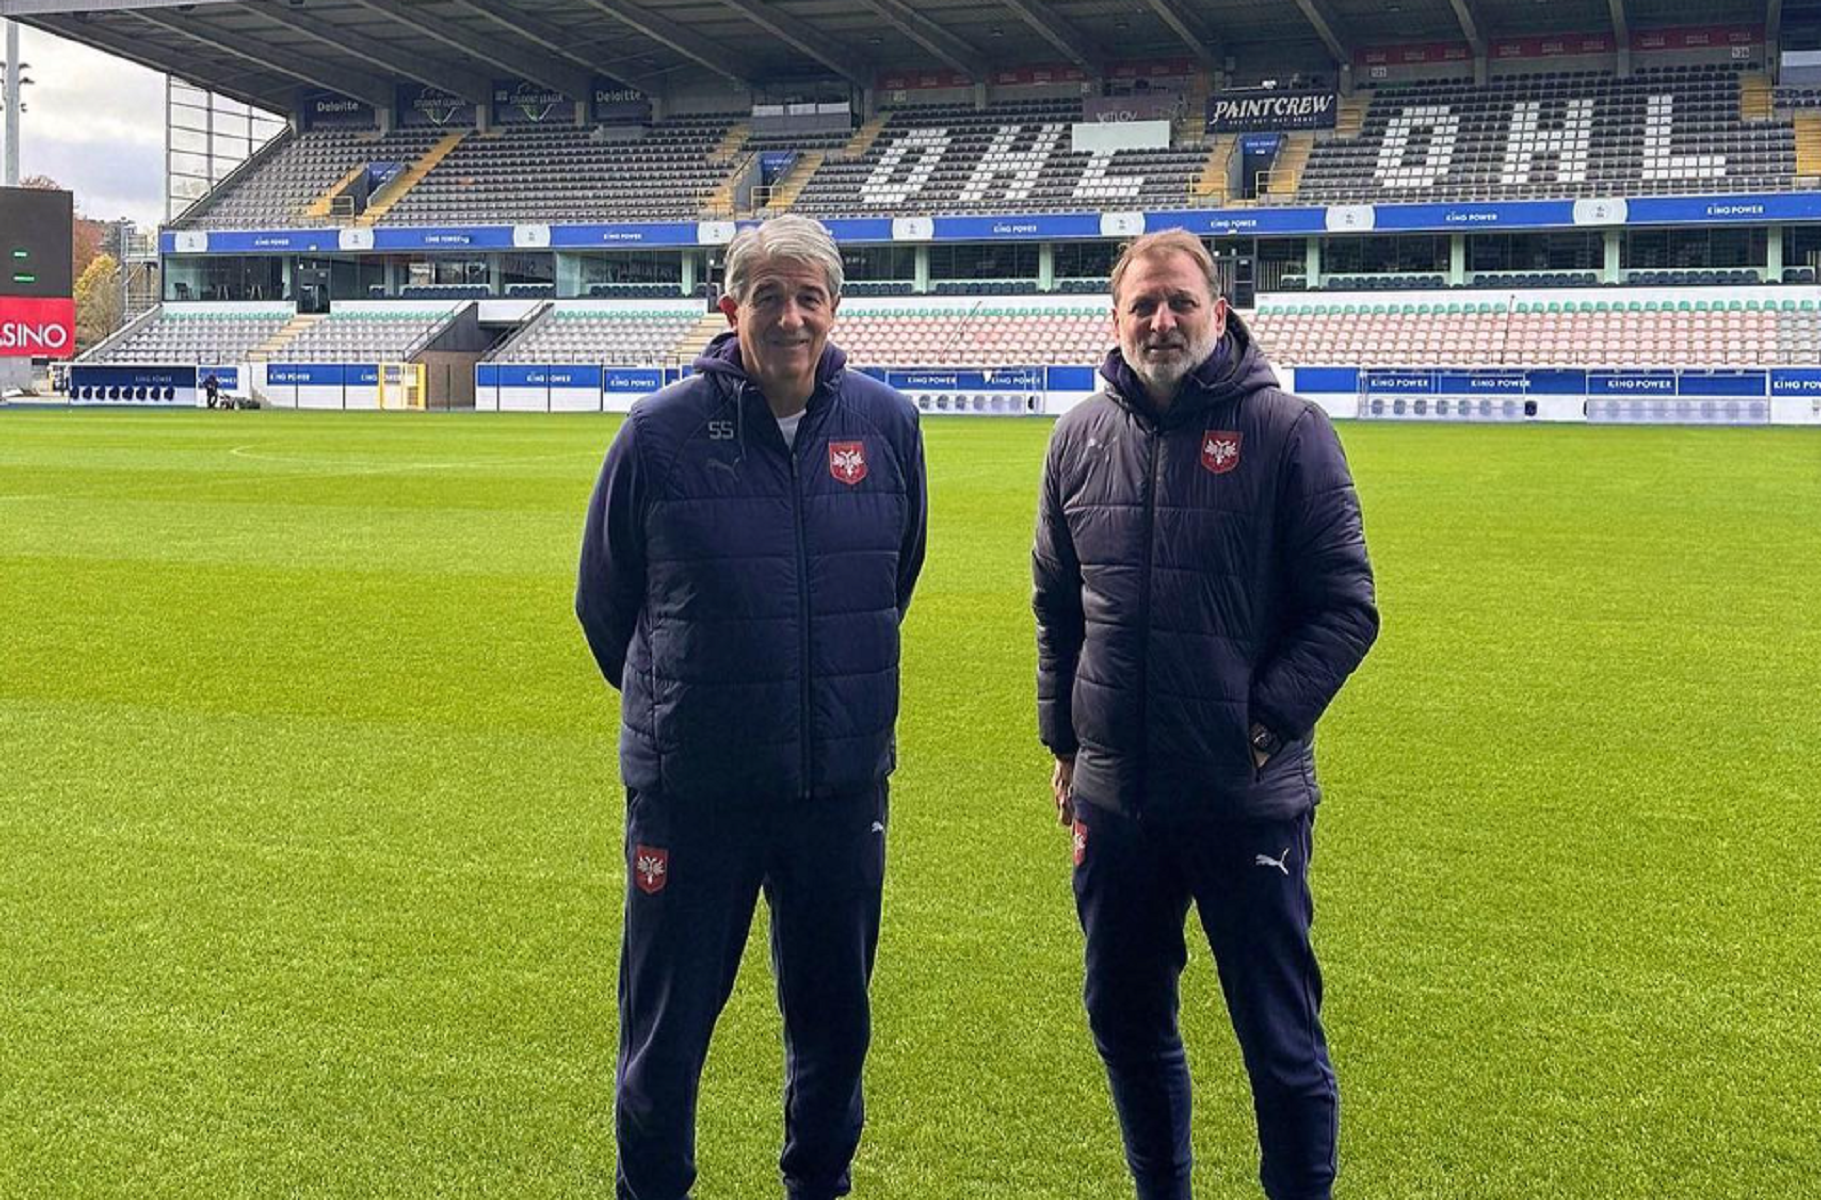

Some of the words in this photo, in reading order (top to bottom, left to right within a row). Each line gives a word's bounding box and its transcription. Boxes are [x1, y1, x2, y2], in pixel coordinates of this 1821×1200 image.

[596, 90, 642, 102] Deloitte
[316, 101, 359, 112] Deloitte
[1208, 95, 1334, 125] PAINTCREW
[1707, 205, 1730, 215] KING
[1731, 204, 1764, 214] POWER
[1445, 213, 1467, 222] KING
[1468, 212, 1498, 221] POWER
[0, 323, 67, 348] SINO
[610, 379, 629, 387] KING
[630, 379, 655, 387] POWER
[929, 376, 957, 384] POWER
[1371, 379, 1395, 387] KING
[1396, 379, 1428, 387] POWER
[1471, 379, 1495, 387] KING
[1607, 380, 1634, 388] KING
[1635, 379, 1672, 388] POWER
[1773, 380, 1801, 389] KING
